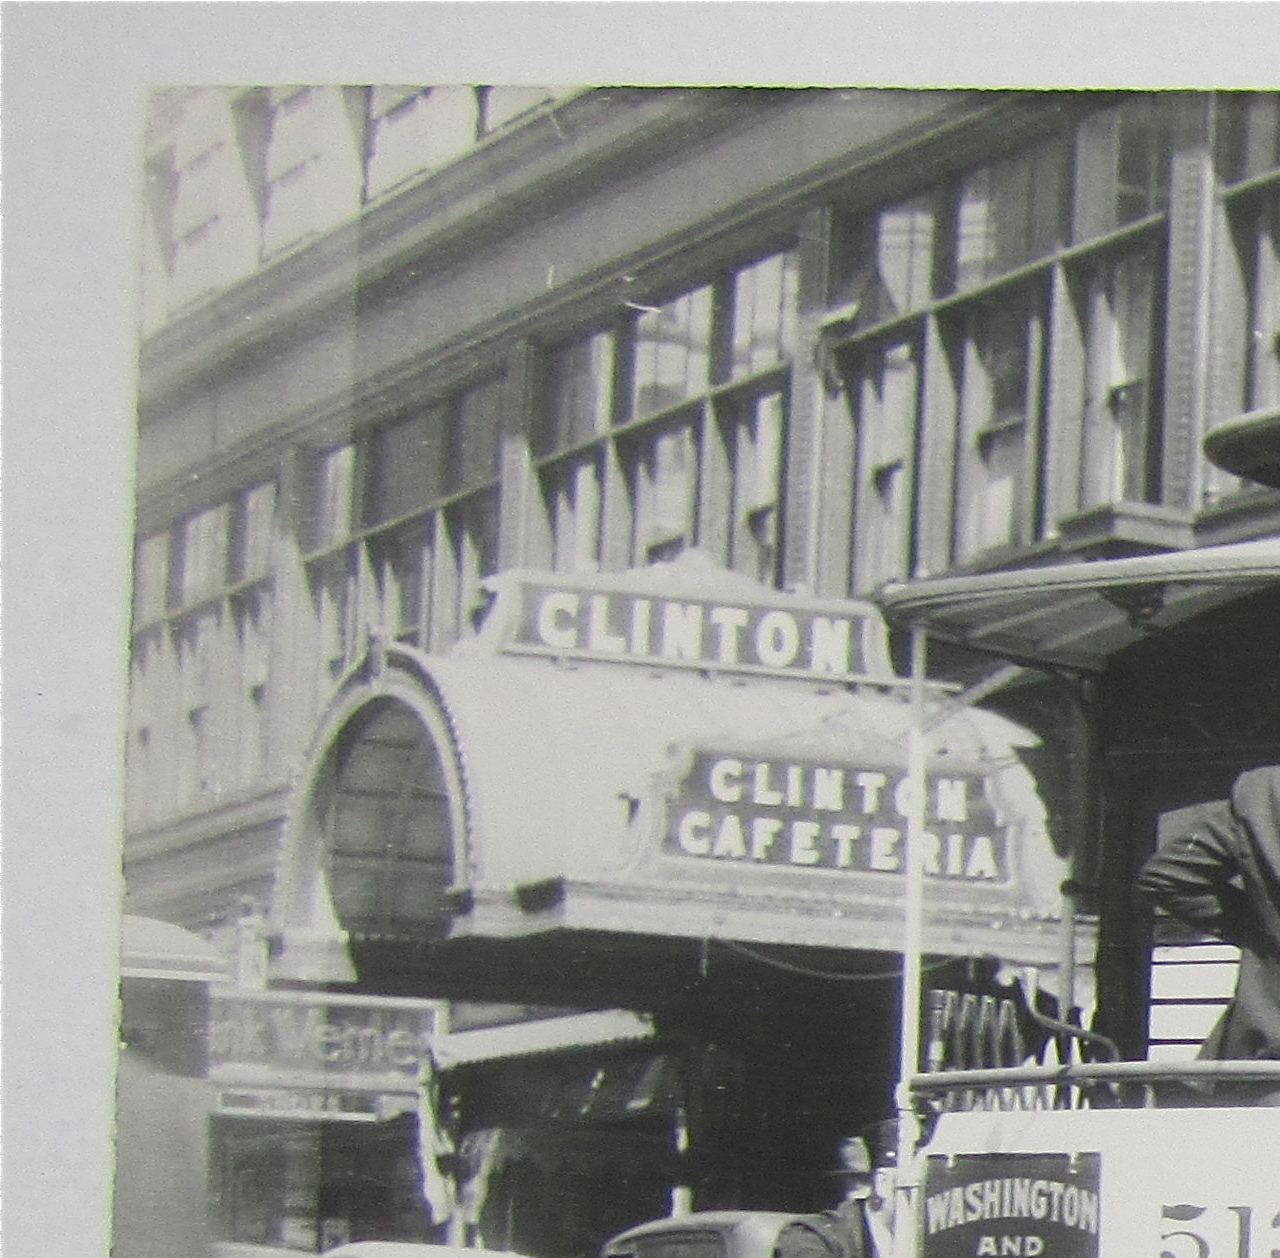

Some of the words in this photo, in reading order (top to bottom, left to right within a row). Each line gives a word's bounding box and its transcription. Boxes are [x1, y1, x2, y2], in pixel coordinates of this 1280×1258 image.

[537, 591, 850, 676] CLINTON
[708, 757, 968, 825] CLINTON
[677, 809, 1001, 880] CAFETERIA
[926, 1178, 1098, 1233] WASHINGTON
[977, 1235, 1044, 1257] AND
